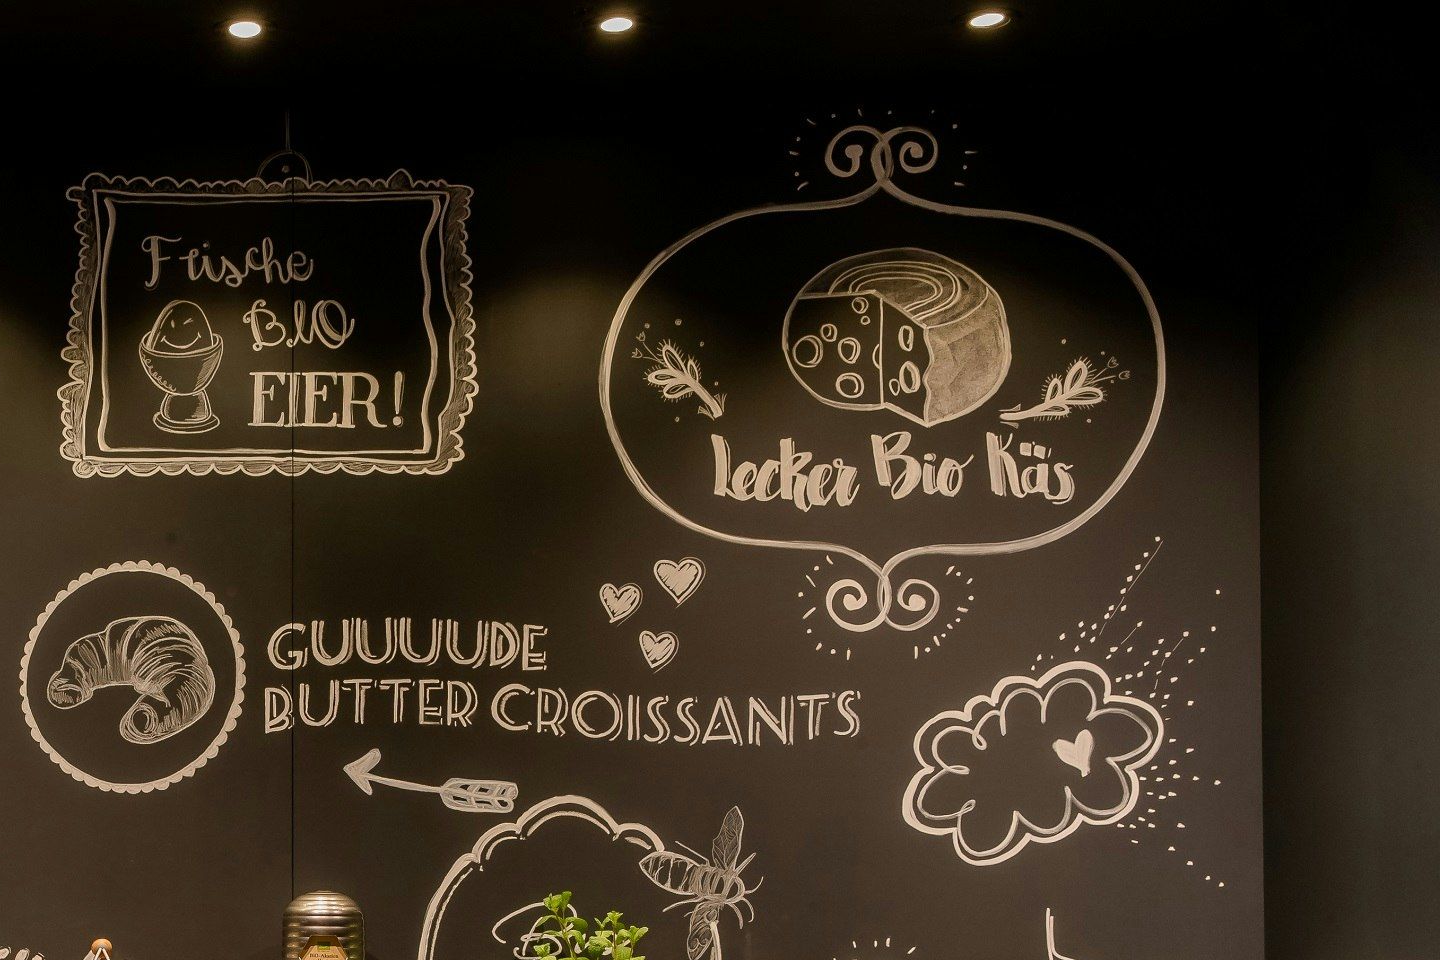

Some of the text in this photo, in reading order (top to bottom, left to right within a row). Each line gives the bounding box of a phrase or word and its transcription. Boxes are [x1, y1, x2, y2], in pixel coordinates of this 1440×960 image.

[141, 234, 314, 292] Frische
[247, 370, 405, 429] EIER!
[870, 431, 975, 500] Bio
[984, 431, 1076, 506] Käs
[267, 617, 549, 671] GUUUUDE
[264, 678, 863, 748] BUTTER CROISSANTS
